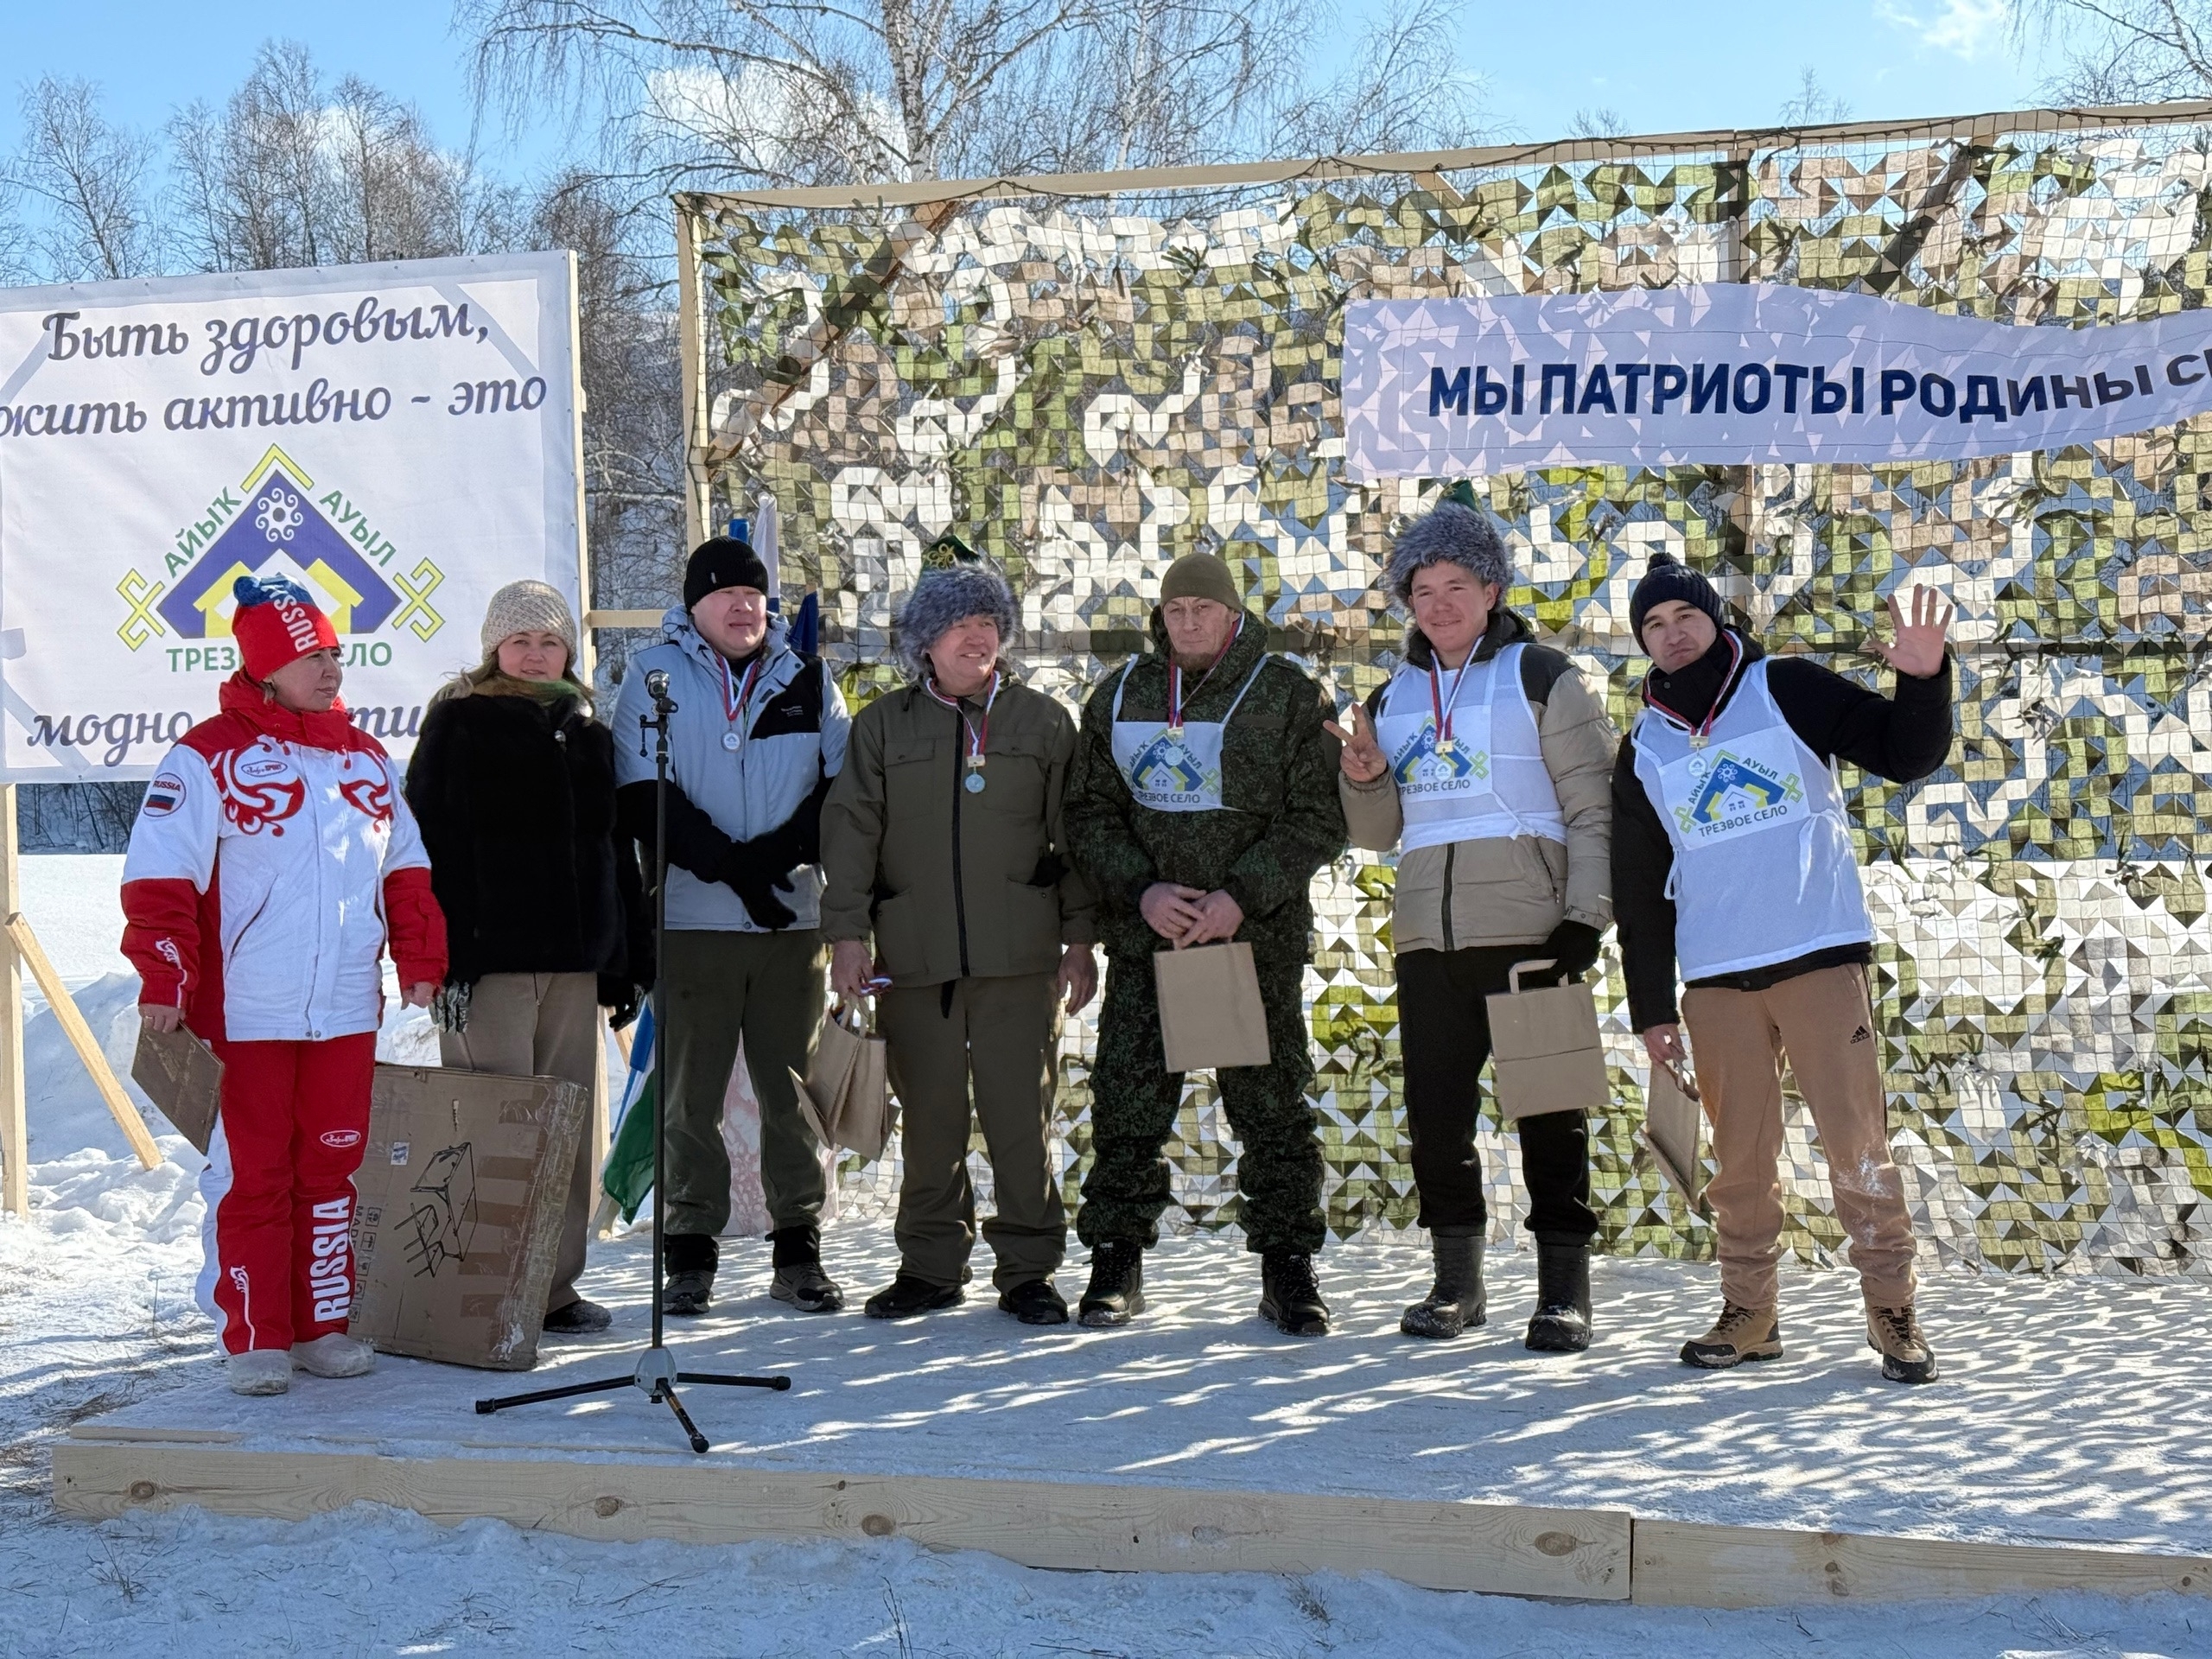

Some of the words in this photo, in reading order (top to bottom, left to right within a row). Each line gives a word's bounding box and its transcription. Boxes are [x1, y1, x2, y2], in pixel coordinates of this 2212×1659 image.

[42, 311, 189, 361] Быть
[200, 296, 489, 376] здоровым,
[0, 400, 148, 437] жить
[163, 378, 392, 431] активно
[448, 377, 547, 416] это
[1428, 365, 1524, 416] МЫ
[1539, 362, 1865, 416] ПАТРИОТЫ
[1880, 365, 2154, 424] РОДИНЫ
[319, 489, 397, 568] АУЫЛ
[27, 709, 193, 767] модно
[153, 779, 181, 792] RUSSIA
[1440, 779, 1471, 791] СЕЛО
[1742, 757, 1779, 780] АУЫЛ
[1170, 793, 1201, 804] СЕЛО
[1698, 814, 1753, 837] ТРЕЗВОЕ
[1753, 804, 1788, 823] СЕЛО
[309, 1195, 352, 1323] RUSSIA
